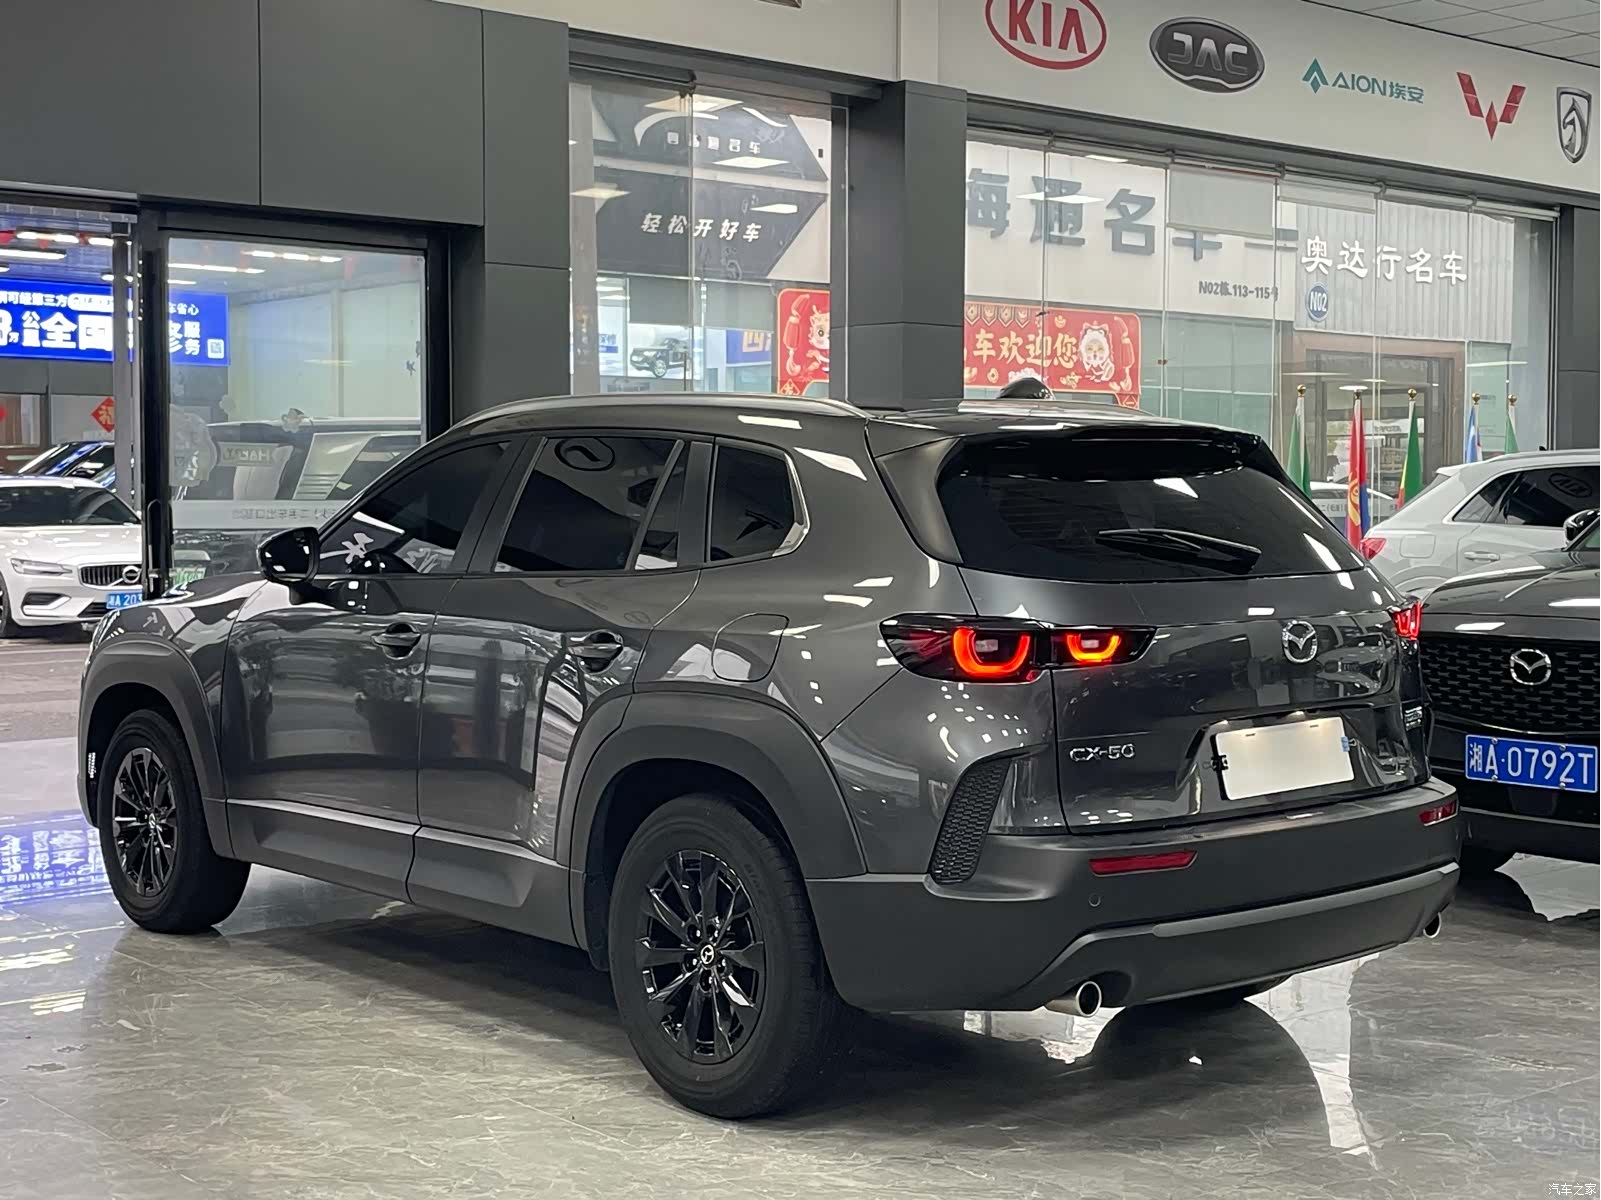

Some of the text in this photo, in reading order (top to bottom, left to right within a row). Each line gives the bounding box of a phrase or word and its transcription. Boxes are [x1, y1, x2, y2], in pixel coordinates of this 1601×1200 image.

[1008, 0, 1088, 54] KIA
[1167, 32, 1249, 76] JAC
[641, 212, 762, 243] 轻松开好车
[1301, 235, 1468, 286] 奥达行名车
[973, 328, 1078, 369] 车欢迎您
[1069, 743, 1136, 762] CX-50
